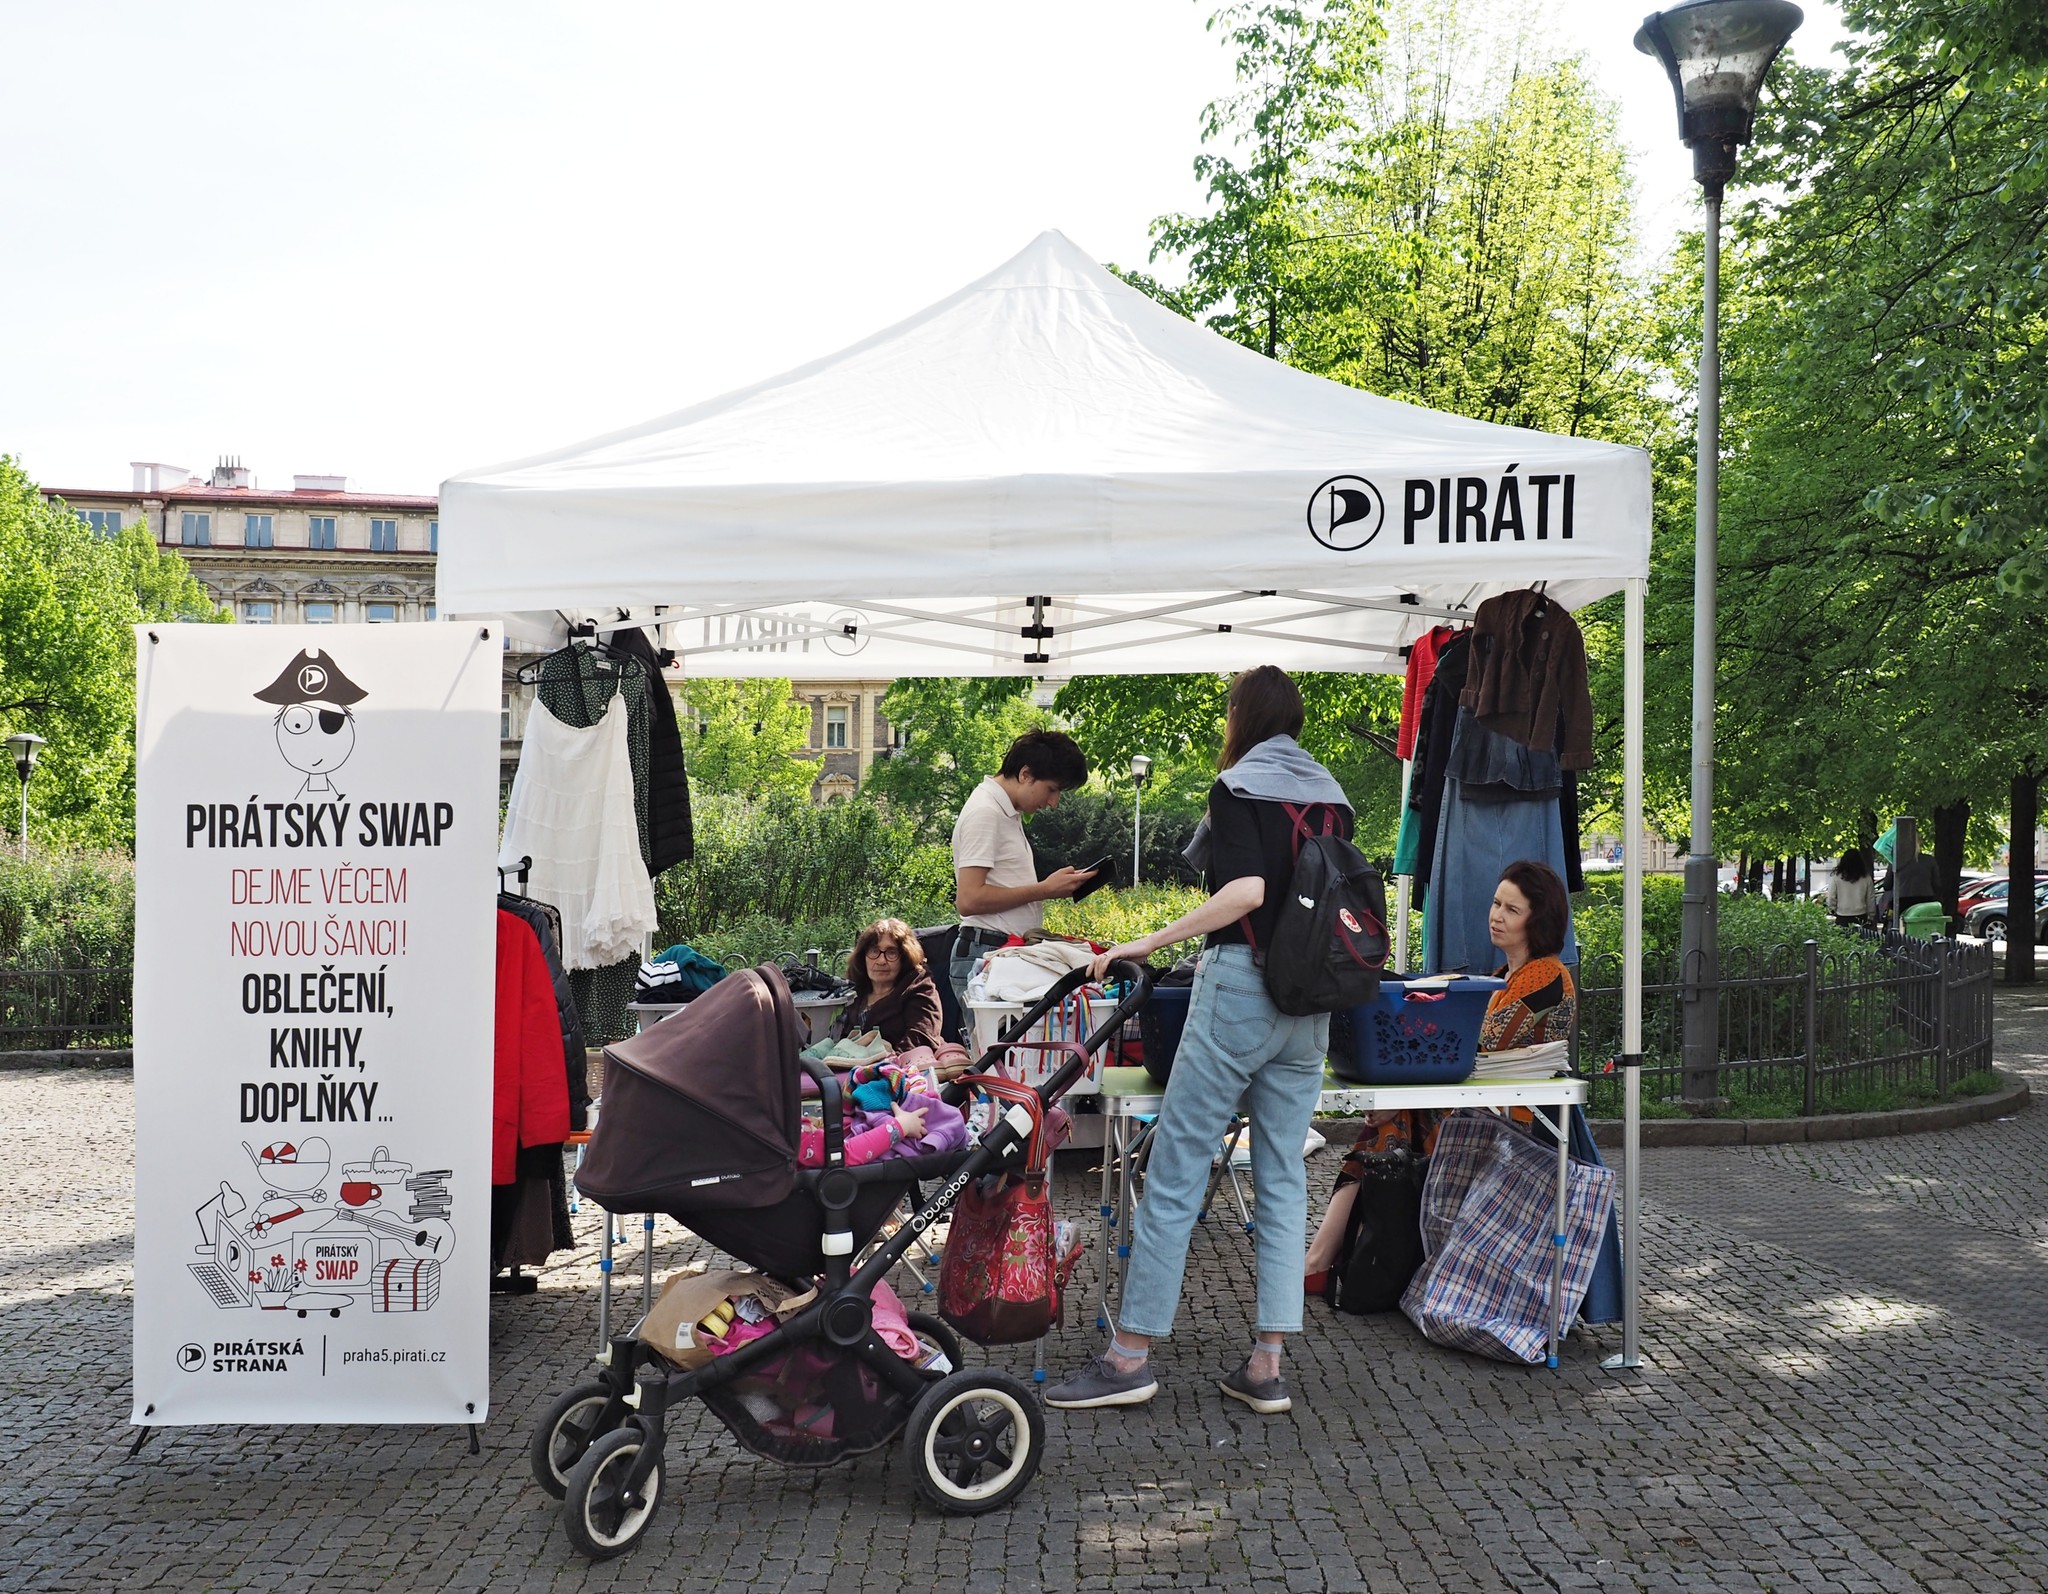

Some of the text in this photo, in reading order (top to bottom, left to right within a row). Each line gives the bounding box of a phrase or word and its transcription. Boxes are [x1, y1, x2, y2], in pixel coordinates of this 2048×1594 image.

[1404, 463, 1576, 544] PIRÁTI
[186, 794, 454, 849] PIRÁTSKÝ SWAP
[231, 862, 408, 905] DEJME VĚCEM
[231, 920, 317, 957] NOVOU
[242, 964, 394, 1019] OBLEČENÍ,
[270, 1027, 366, 1073] KNIHY,
[921, 1171, 970, 1219] bugaboo
[315, 1243, 359, 1258] PIRÁTSKÝ
[315, 1259, 359, 1280] SWAP
[212, 1358, 288, 1373] STRANA
[213, 1338, 305, 1356] PIRÁTSKÁ
[343, 1348, 447, 1365] praha5.pirati.cz
